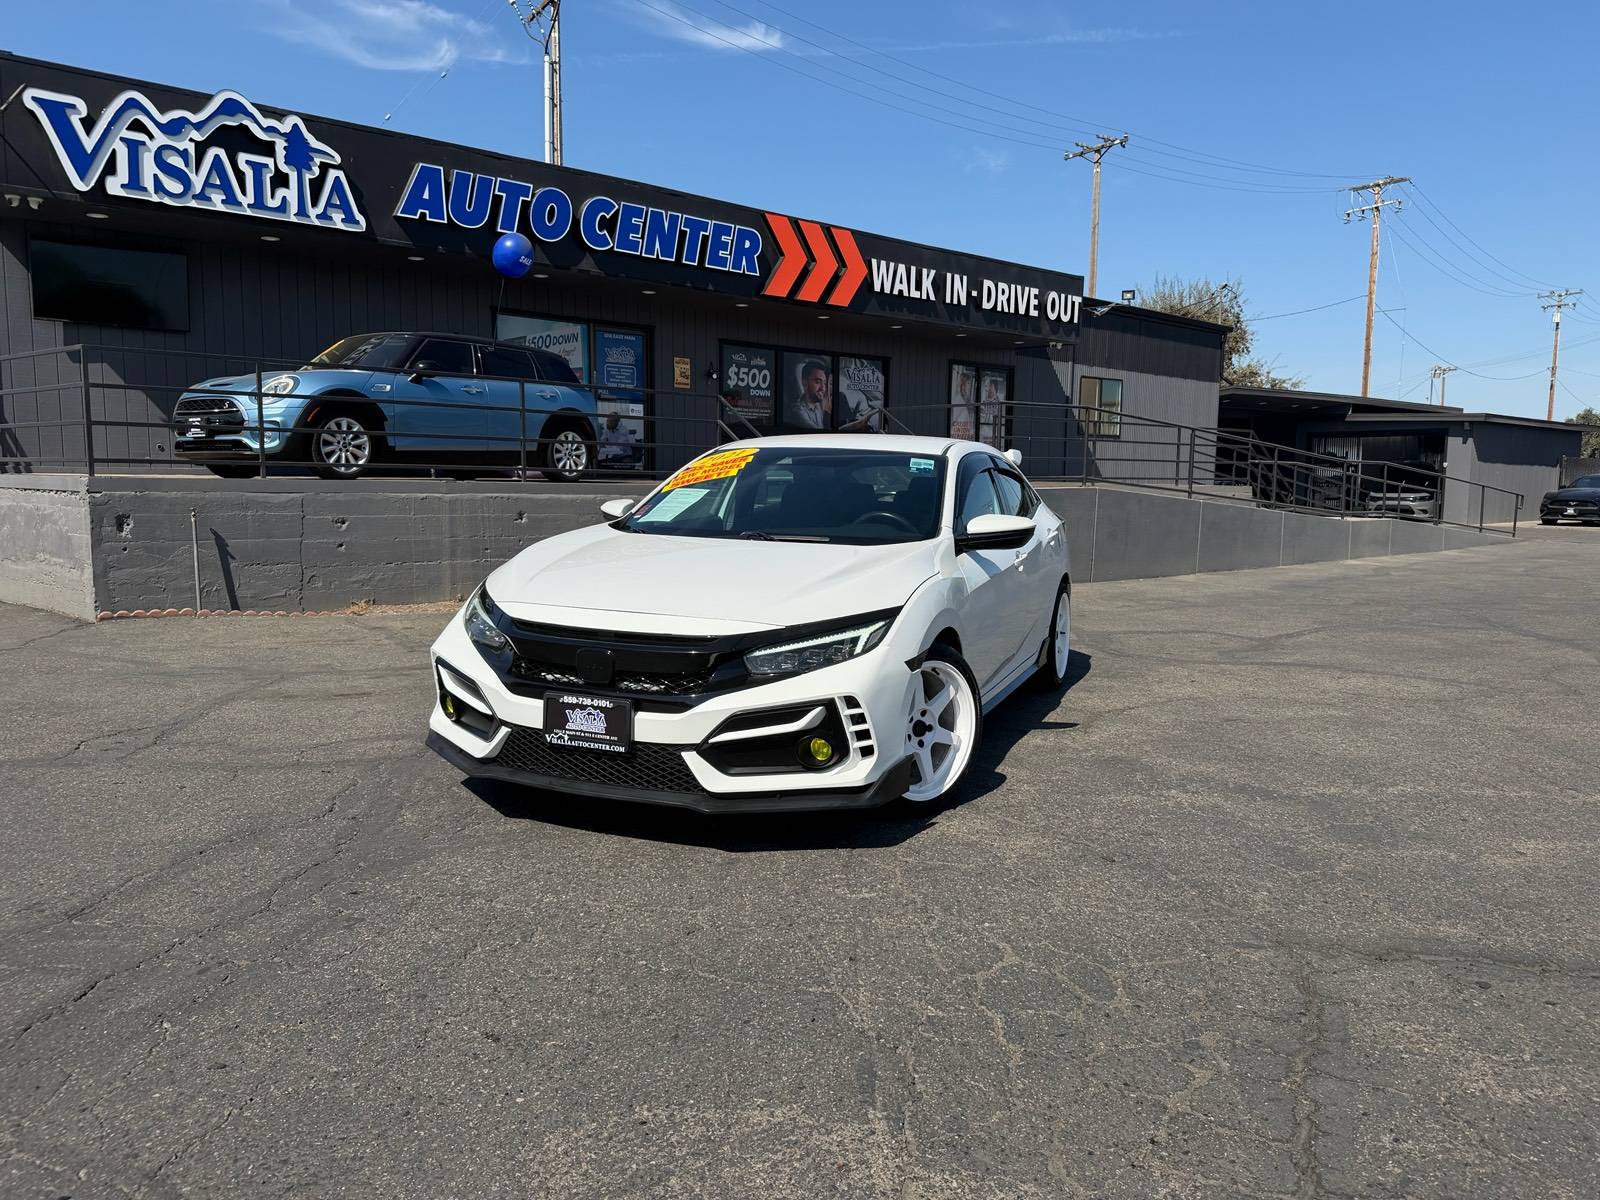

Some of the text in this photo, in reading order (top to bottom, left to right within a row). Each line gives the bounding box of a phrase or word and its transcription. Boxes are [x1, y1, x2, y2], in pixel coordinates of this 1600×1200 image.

[23, 89, 366, 232] VISALIA
[392, 162, 763, 276] AUTO CENTER
[871, 258, 937, 301] WALK
[945, 272, 968, 306] IN
[981, 278, 1040, 318] DRIVE
[1046, 290, 1083, 324] OUT
[552, 332, 579, 346] DOWN
[727, 364, 771, 389] $500
[846, 367, 881, 384] VISALIA
[750, 389, 771, 397] DOWN
[563, 695, 609, 708] 559-738-0101
[565, 707, 607, 728] VISALIA
[566, 722, 606, 734] AUTO CENTER
